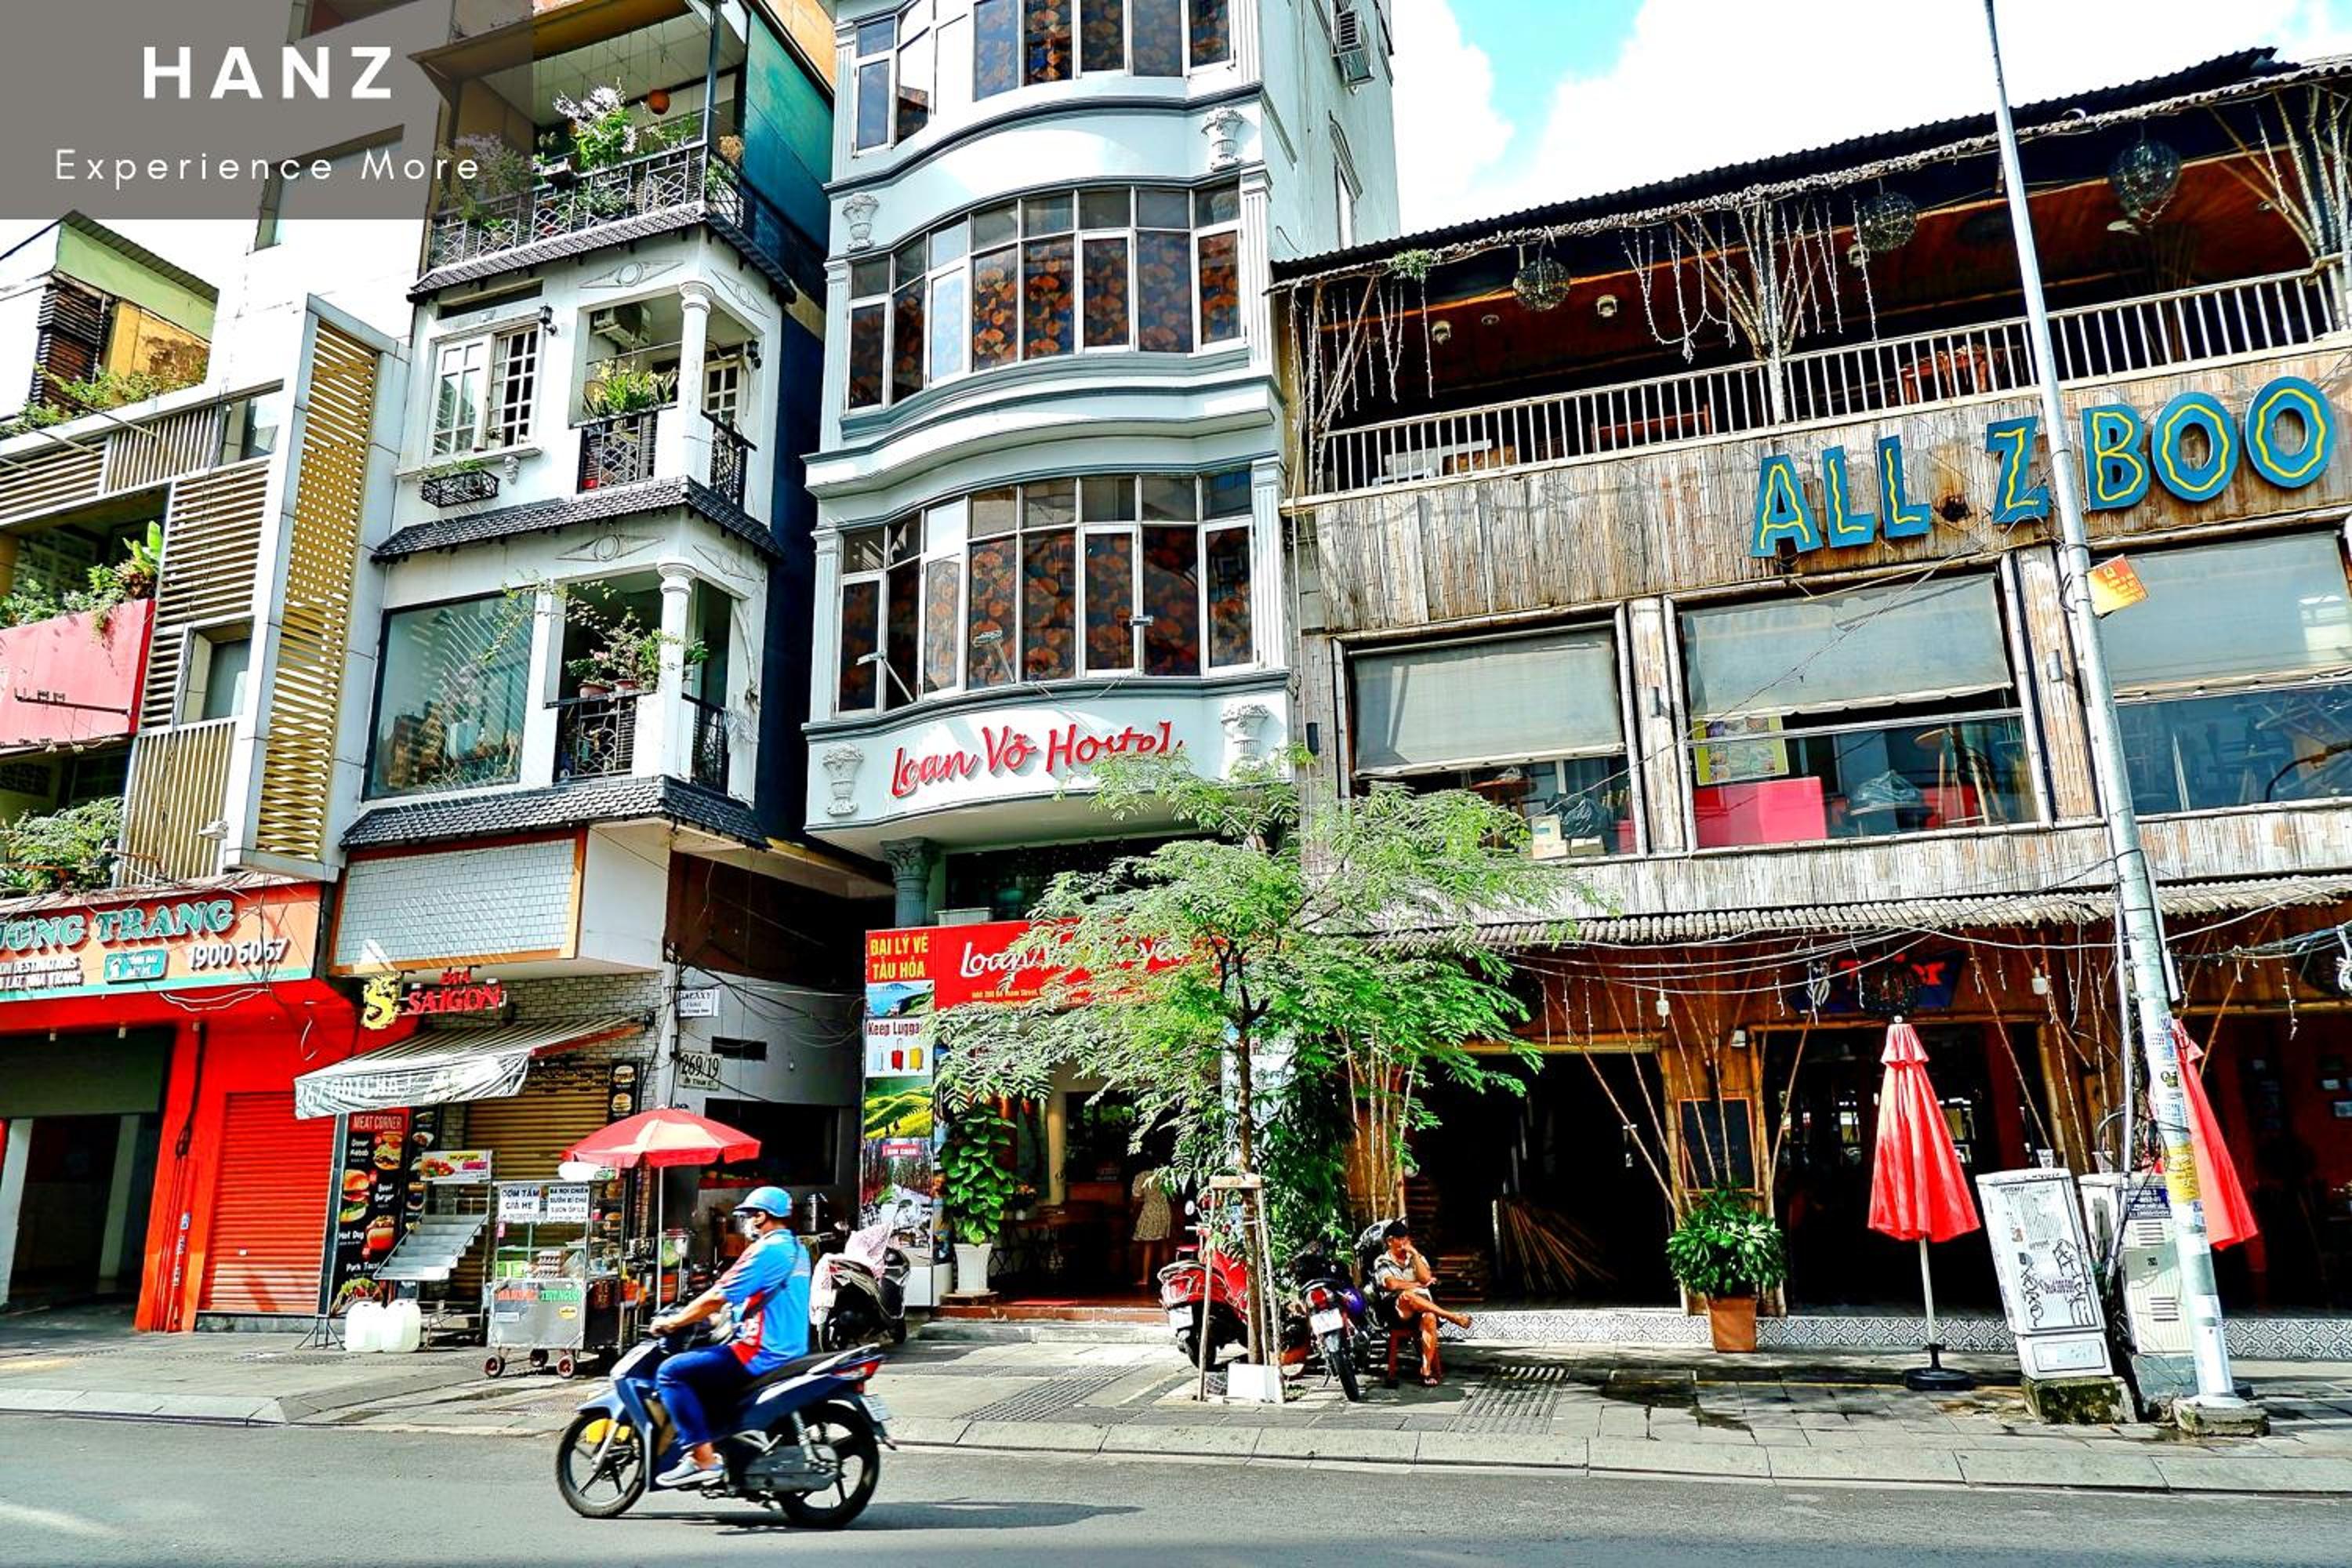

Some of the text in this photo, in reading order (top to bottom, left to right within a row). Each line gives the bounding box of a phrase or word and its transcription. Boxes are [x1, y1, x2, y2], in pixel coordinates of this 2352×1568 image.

[1751, 376, 2336, 557] ALL Z BOO
[892, 747, 977, 797] Loan
[96, 899, 234, 941] TRANG
[189, 946, 233, 969] 1900
[870, 938, 891, 957] ĐẠI
[895, 934, 910, 955] LÝ
[873, 955, 925, 979] TÀU HỎA
[868, 1022, 890, 1036] Keep
